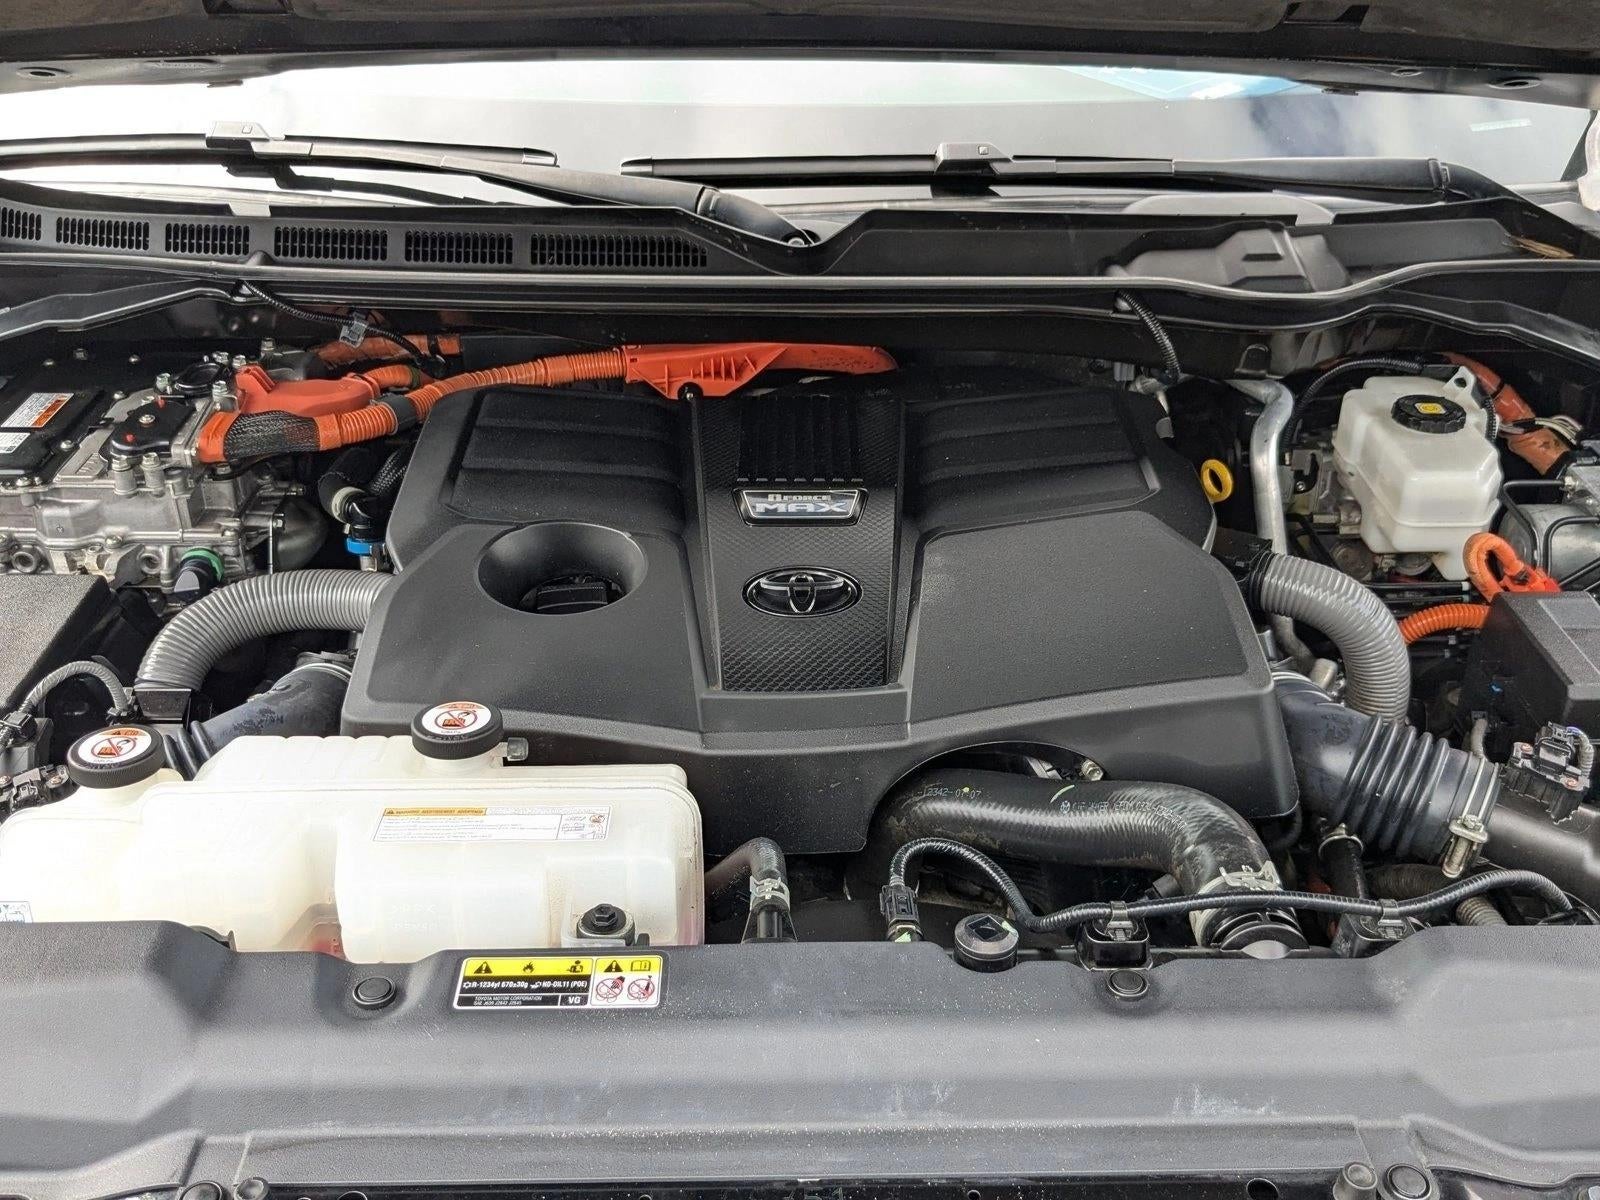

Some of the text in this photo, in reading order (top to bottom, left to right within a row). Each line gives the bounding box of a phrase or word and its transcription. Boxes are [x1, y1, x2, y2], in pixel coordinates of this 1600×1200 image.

[755, 502, 848, 513] MAX
[570, 980, 588, 988] (POE)
[568, 996, 582, 1004] VG
